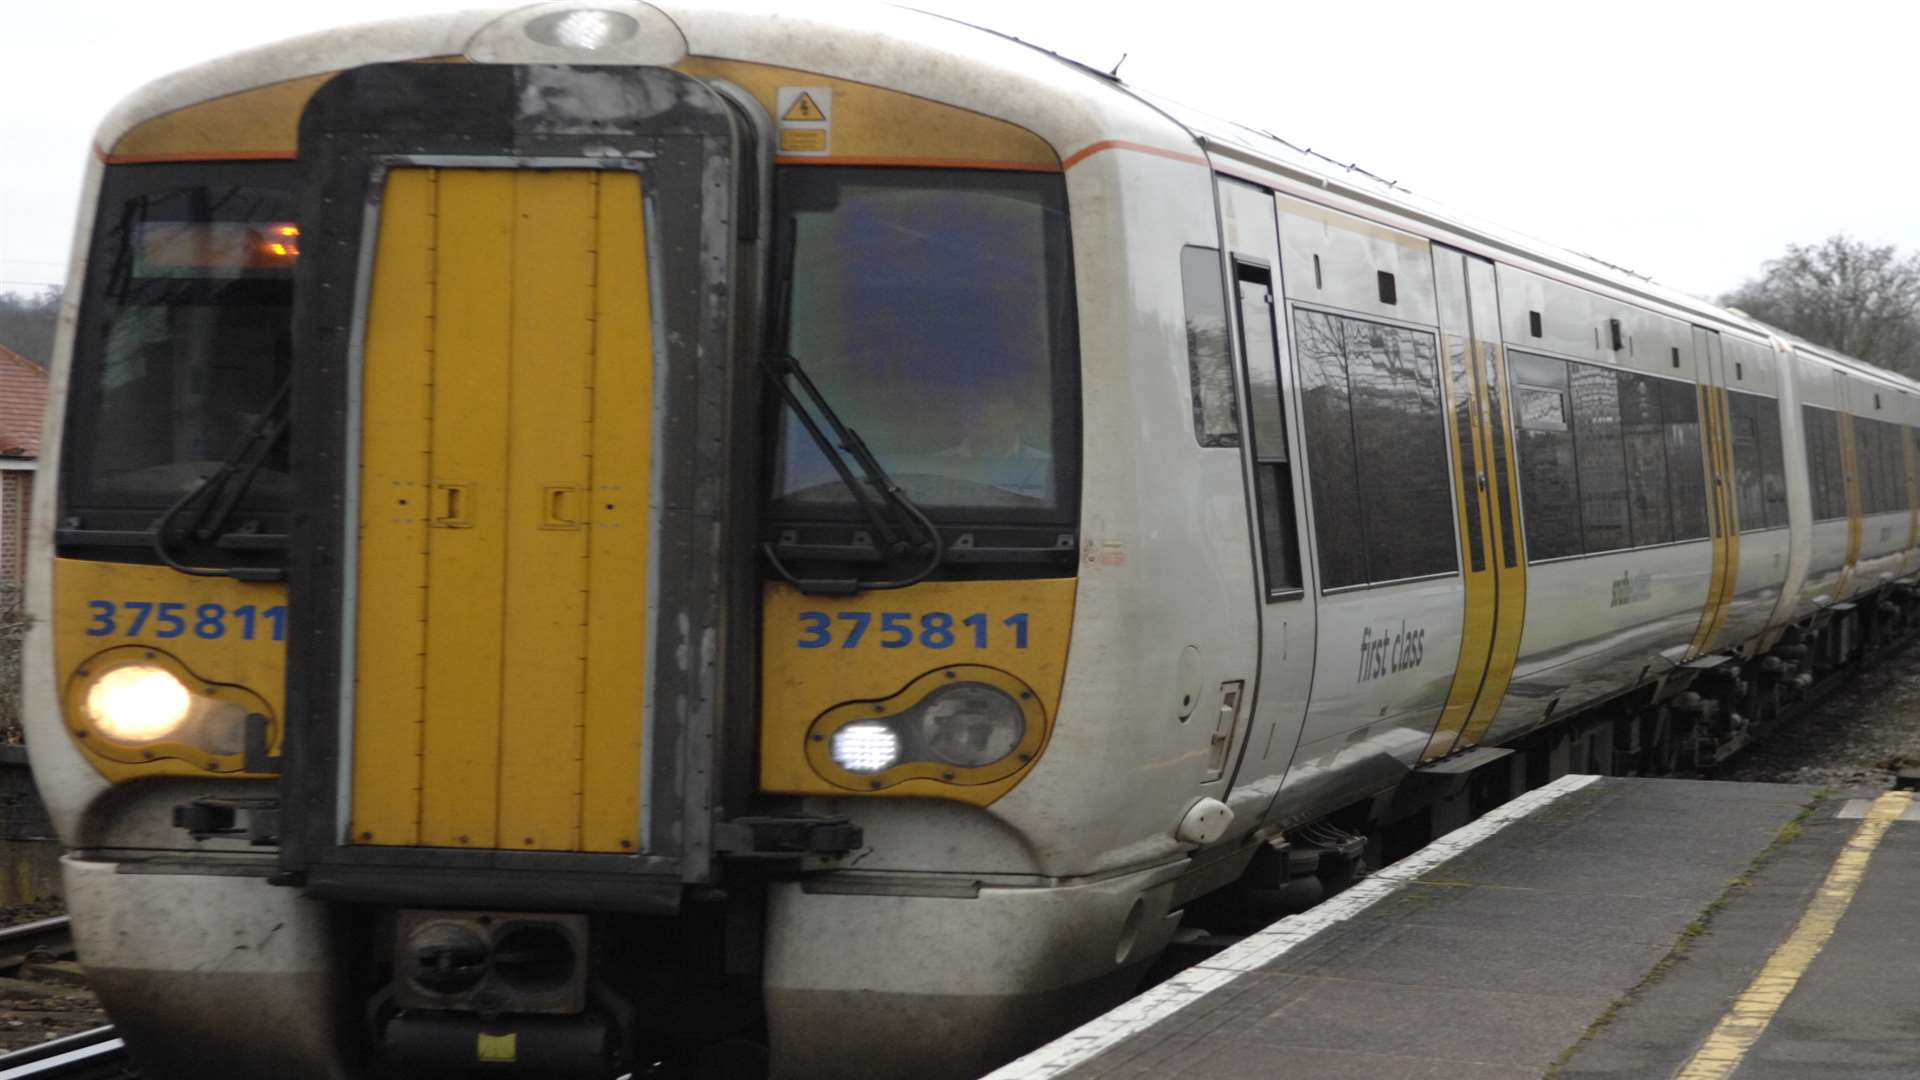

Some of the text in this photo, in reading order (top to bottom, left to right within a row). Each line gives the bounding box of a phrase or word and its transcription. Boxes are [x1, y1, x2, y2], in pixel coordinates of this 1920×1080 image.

[86, 600, 288, 641] 375811
[797, 611, 1029, 650] 375811
[1358, 619, 1425, 683] first class
